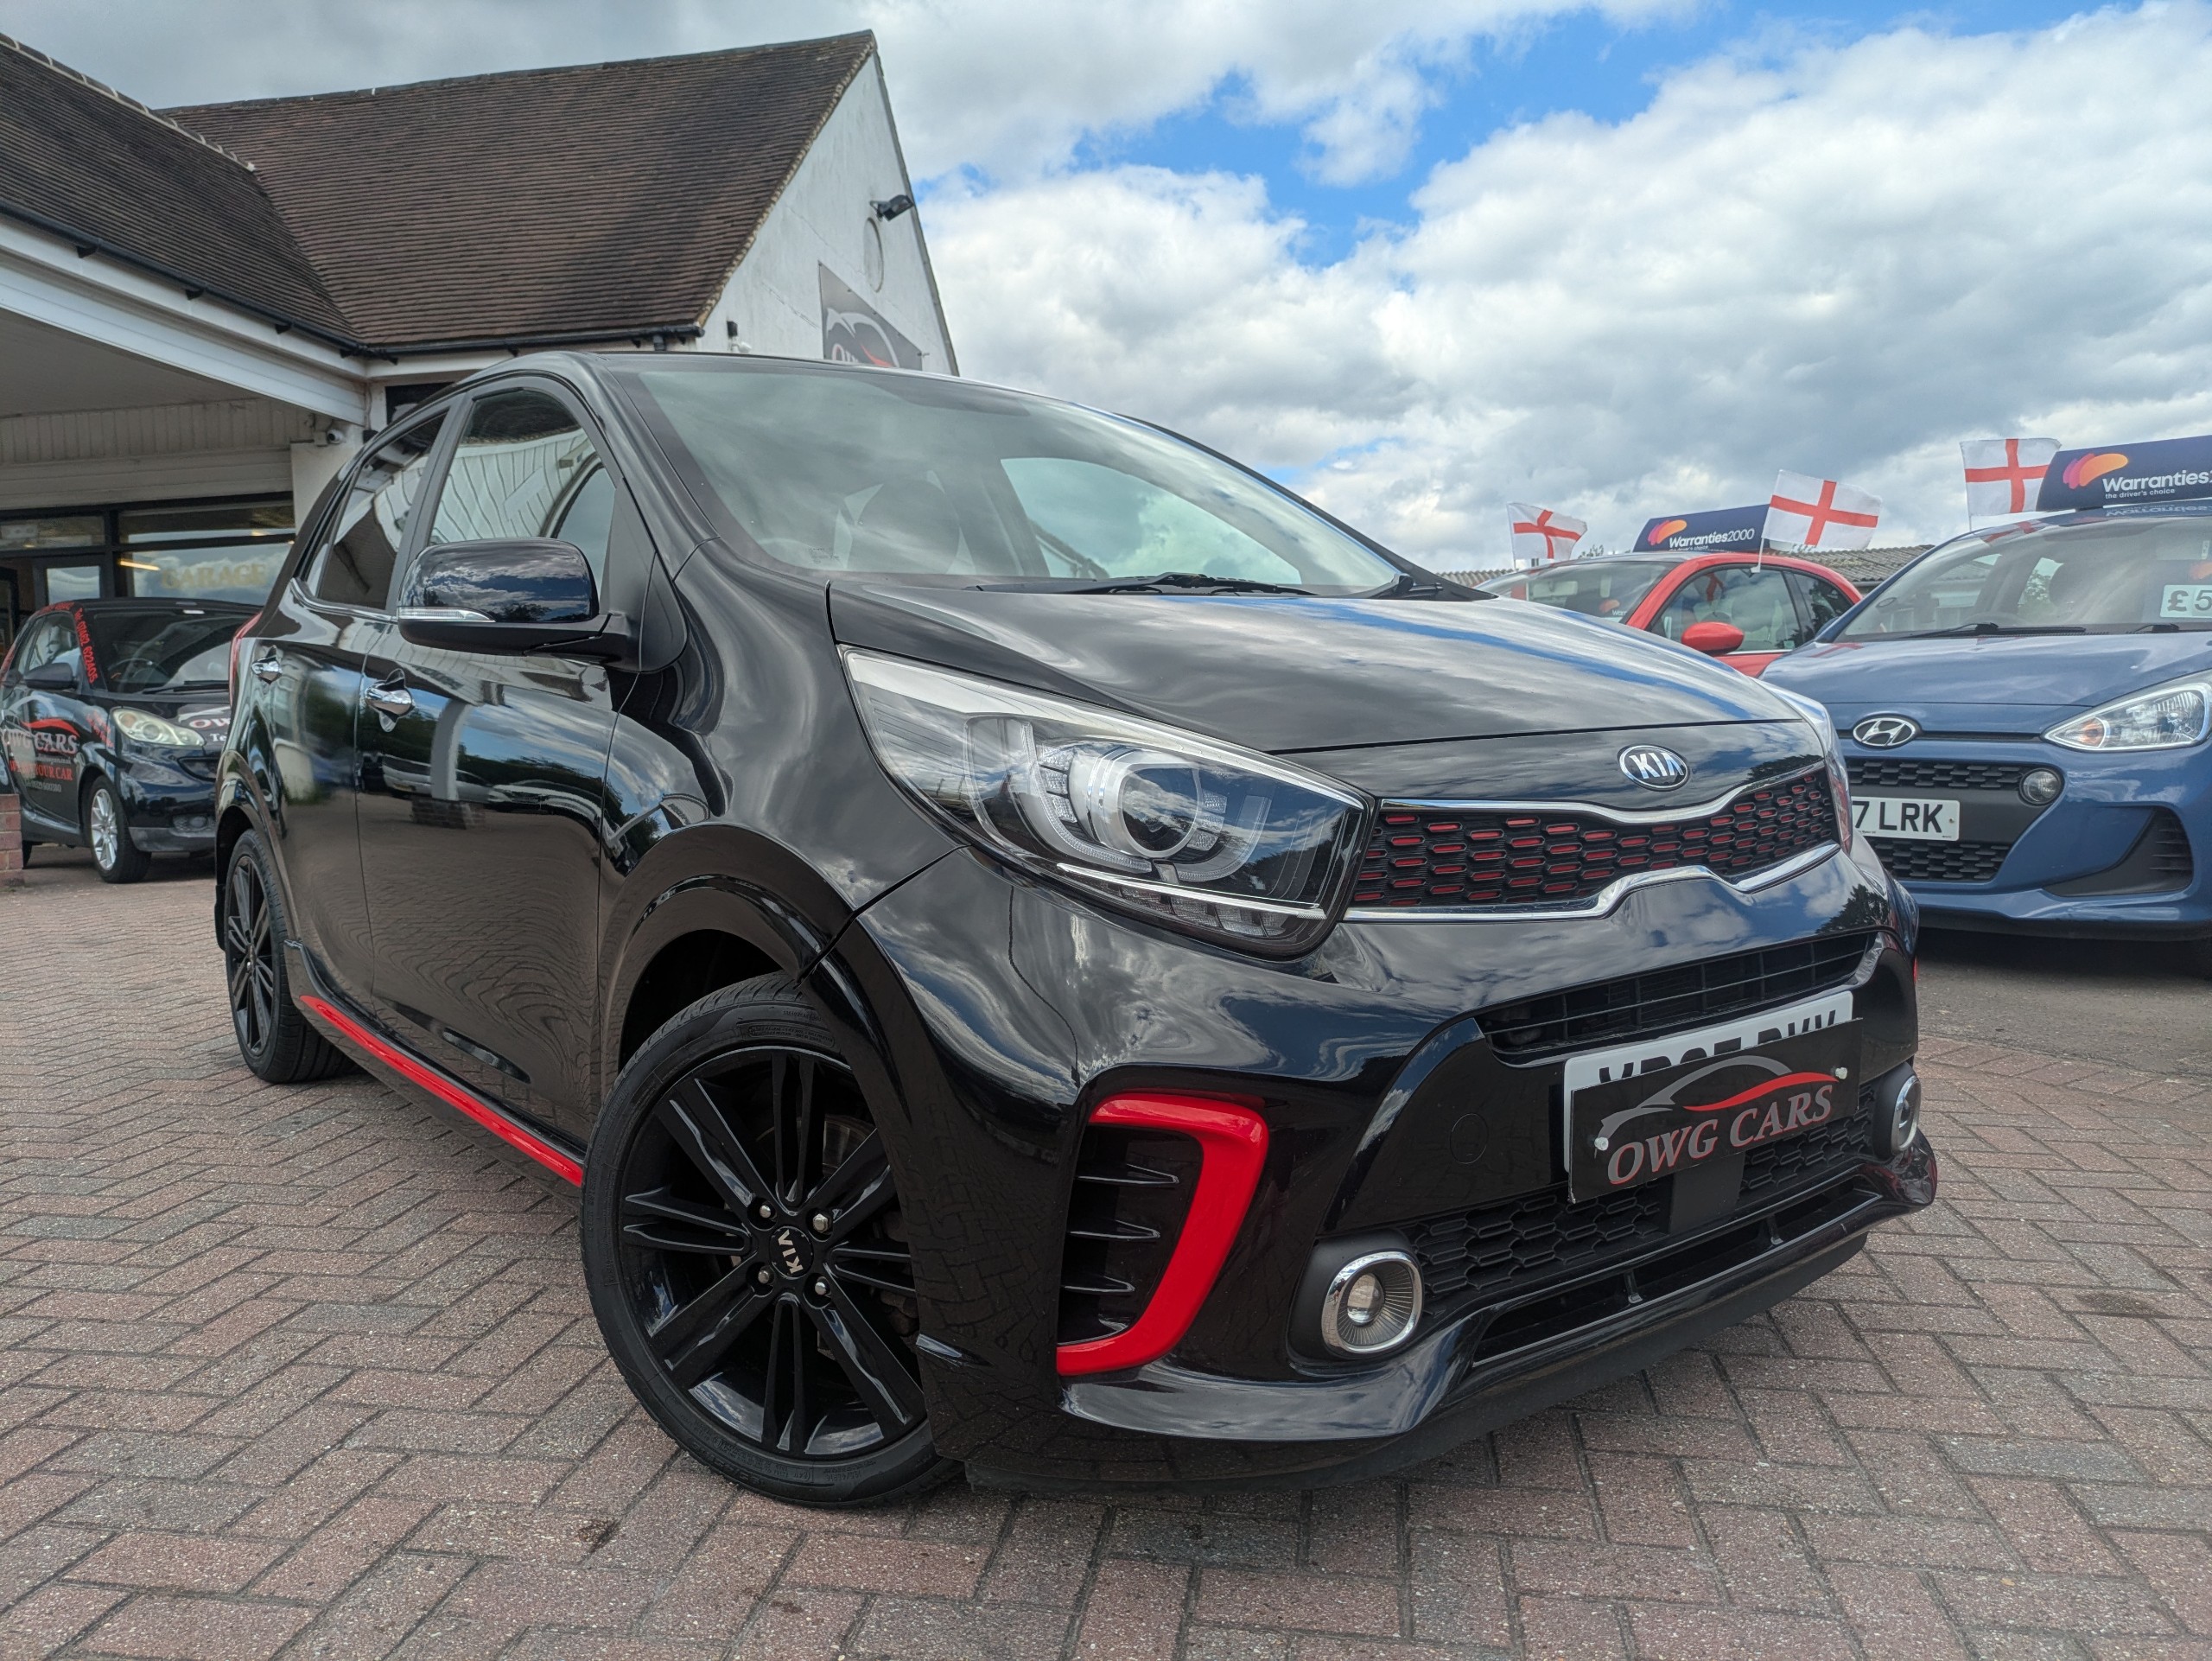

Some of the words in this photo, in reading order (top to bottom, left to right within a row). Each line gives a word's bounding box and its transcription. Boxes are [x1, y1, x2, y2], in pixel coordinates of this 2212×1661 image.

[2119, 489, 2148, 498] driver's
[1669, 528, 1755, 548] Warranties2000
[162, 563, 266, 589] GARAGE
[34, 731, 79, 756] CARS
[1629, 752, 1684, 780] KIA
[1878, 801, 1943, 833] LRK
[1607, 1118, 1718, 1185] OWG
[1729, 1084, 1833, 1148] CARS
[778, 1229, 804, 1275] KIA
